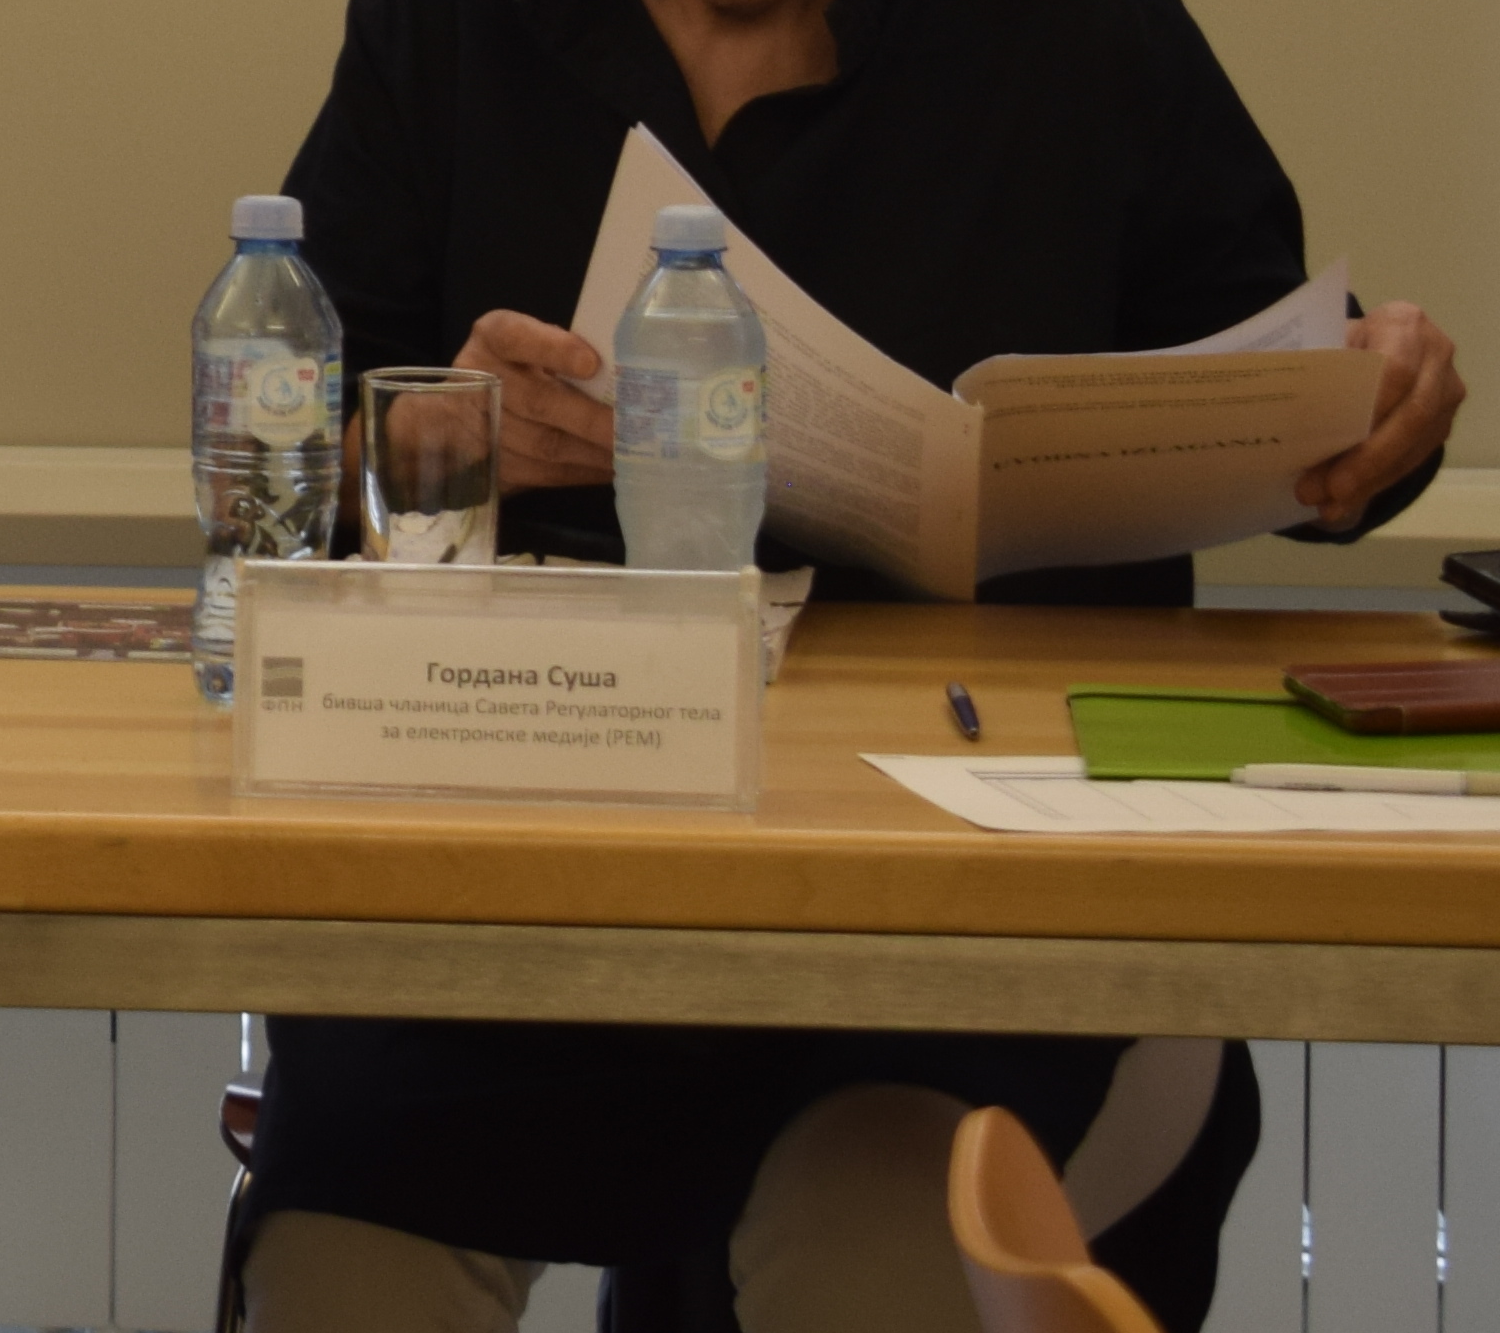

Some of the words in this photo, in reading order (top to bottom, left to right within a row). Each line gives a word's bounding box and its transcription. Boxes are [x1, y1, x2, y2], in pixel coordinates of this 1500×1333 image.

[427, 663, 538, 689] Гордана
[547, 665, 617, 691] Суша
[262, 700, 302, 713] ФПН
[322, 694, 383, 711] бивша
[389, 699, 469, 717] чланица
[475, 698, 539, 717] Савета
[545, 700, 672, 723] Регулаторног
[680, 707, 721, 721] тела
[381, 726, 401, 740] за
[406, 726, 526, 745] електронске
[532, 727, 600, 749] медије
[605, 728, 661, 749] (РЕМ)
